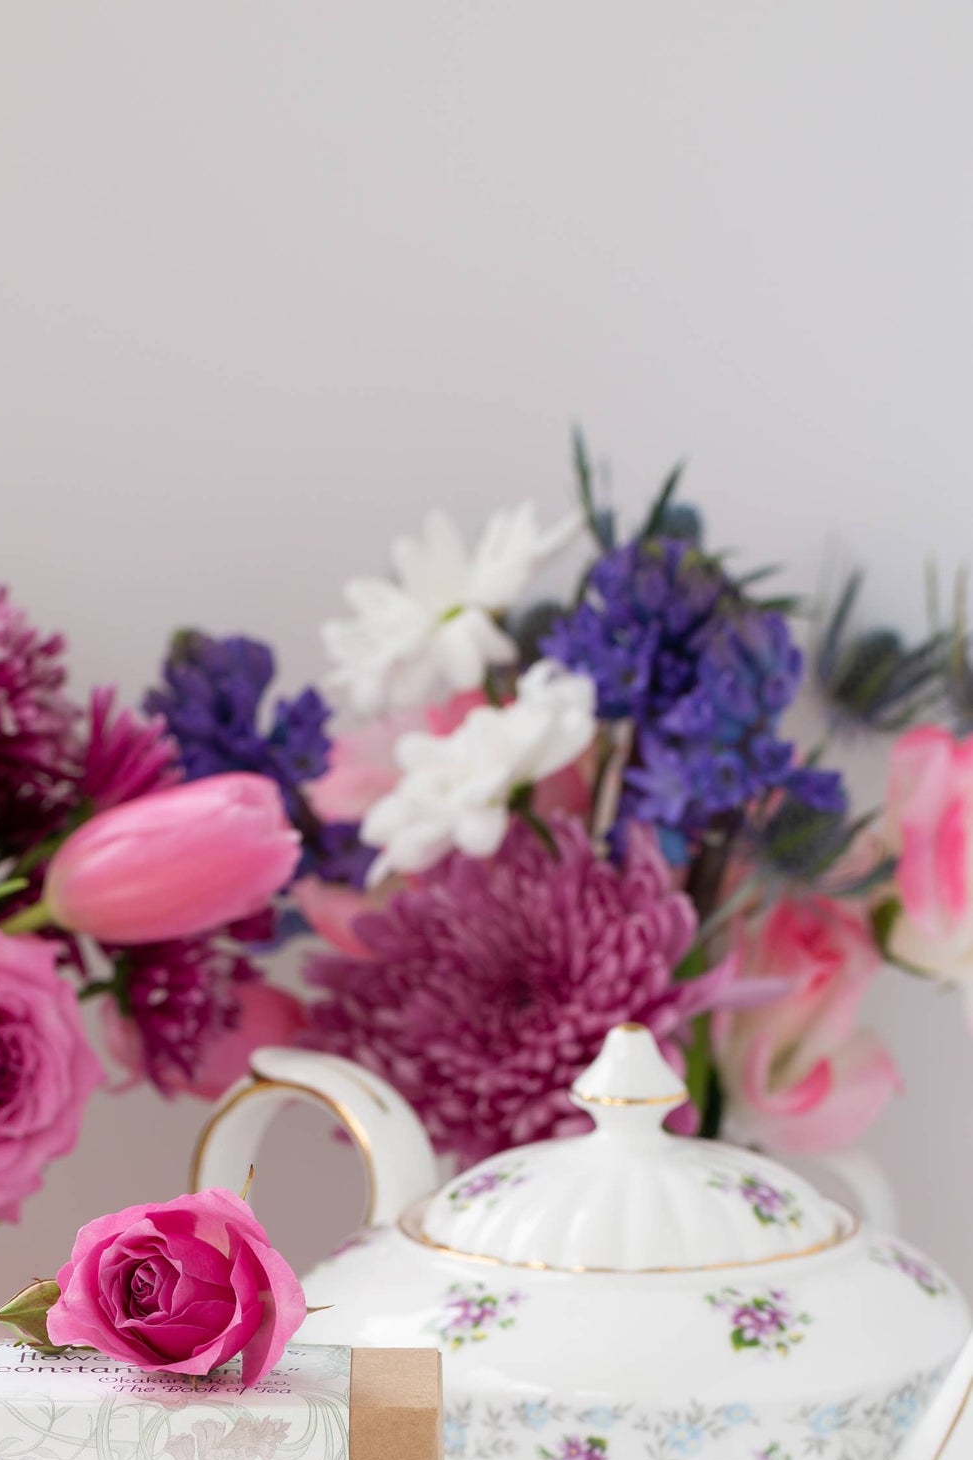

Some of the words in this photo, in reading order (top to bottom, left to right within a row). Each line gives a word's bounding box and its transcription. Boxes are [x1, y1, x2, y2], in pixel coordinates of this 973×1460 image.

[112, 1384, 155, 1392] The
[162, 1384, 219, 1393] Book
[254, 1386, 292, 1394] Tea
